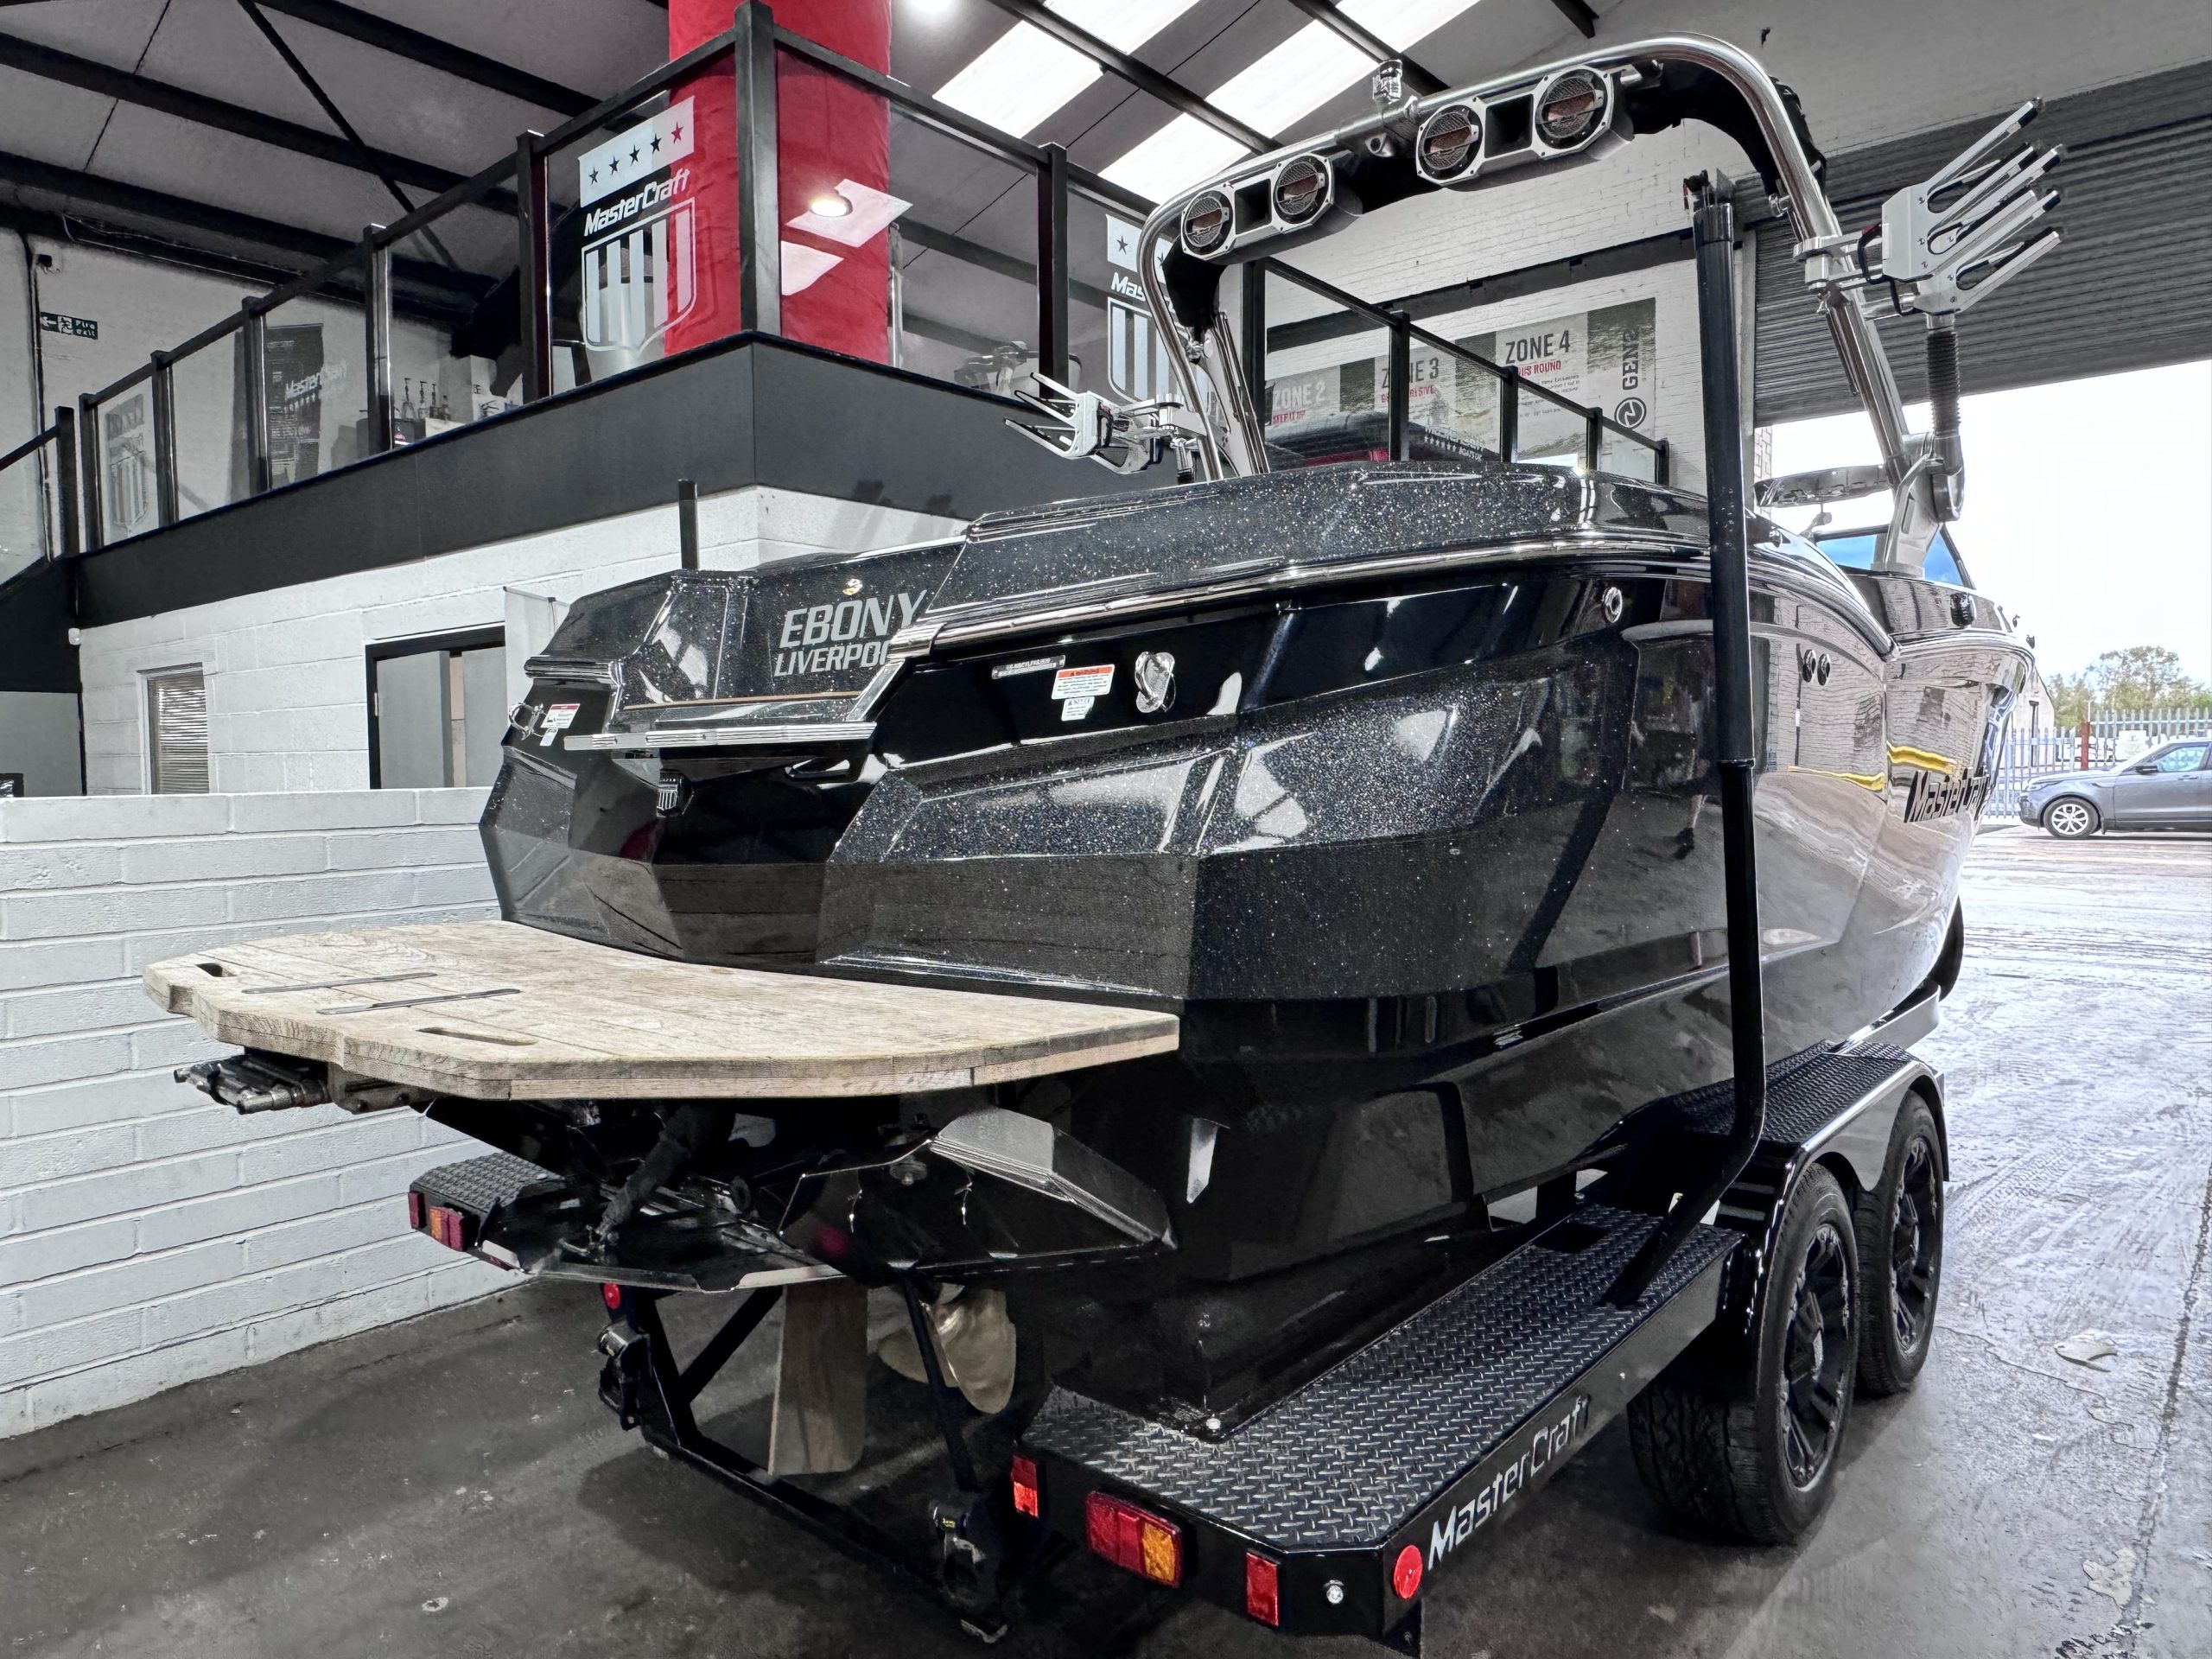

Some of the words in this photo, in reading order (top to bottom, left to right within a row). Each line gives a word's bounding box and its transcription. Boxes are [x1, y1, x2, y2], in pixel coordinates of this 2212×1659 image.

[584, 168, 690, 236] MasterCraft
[1505, 334, 1554, 365] ZONE
[1559, 330, 1570, 353] 4
[1429, 357, 1439, 379] 3
[1273, 384, 1313, 411] ZONE
[1316, 381, 1325, 403] 2
[779, 589, 927, 648] EBONY
[774, 640, 891, 677] LIVERPO
[1428, 1394, 1591, 1571] MasterCraft
